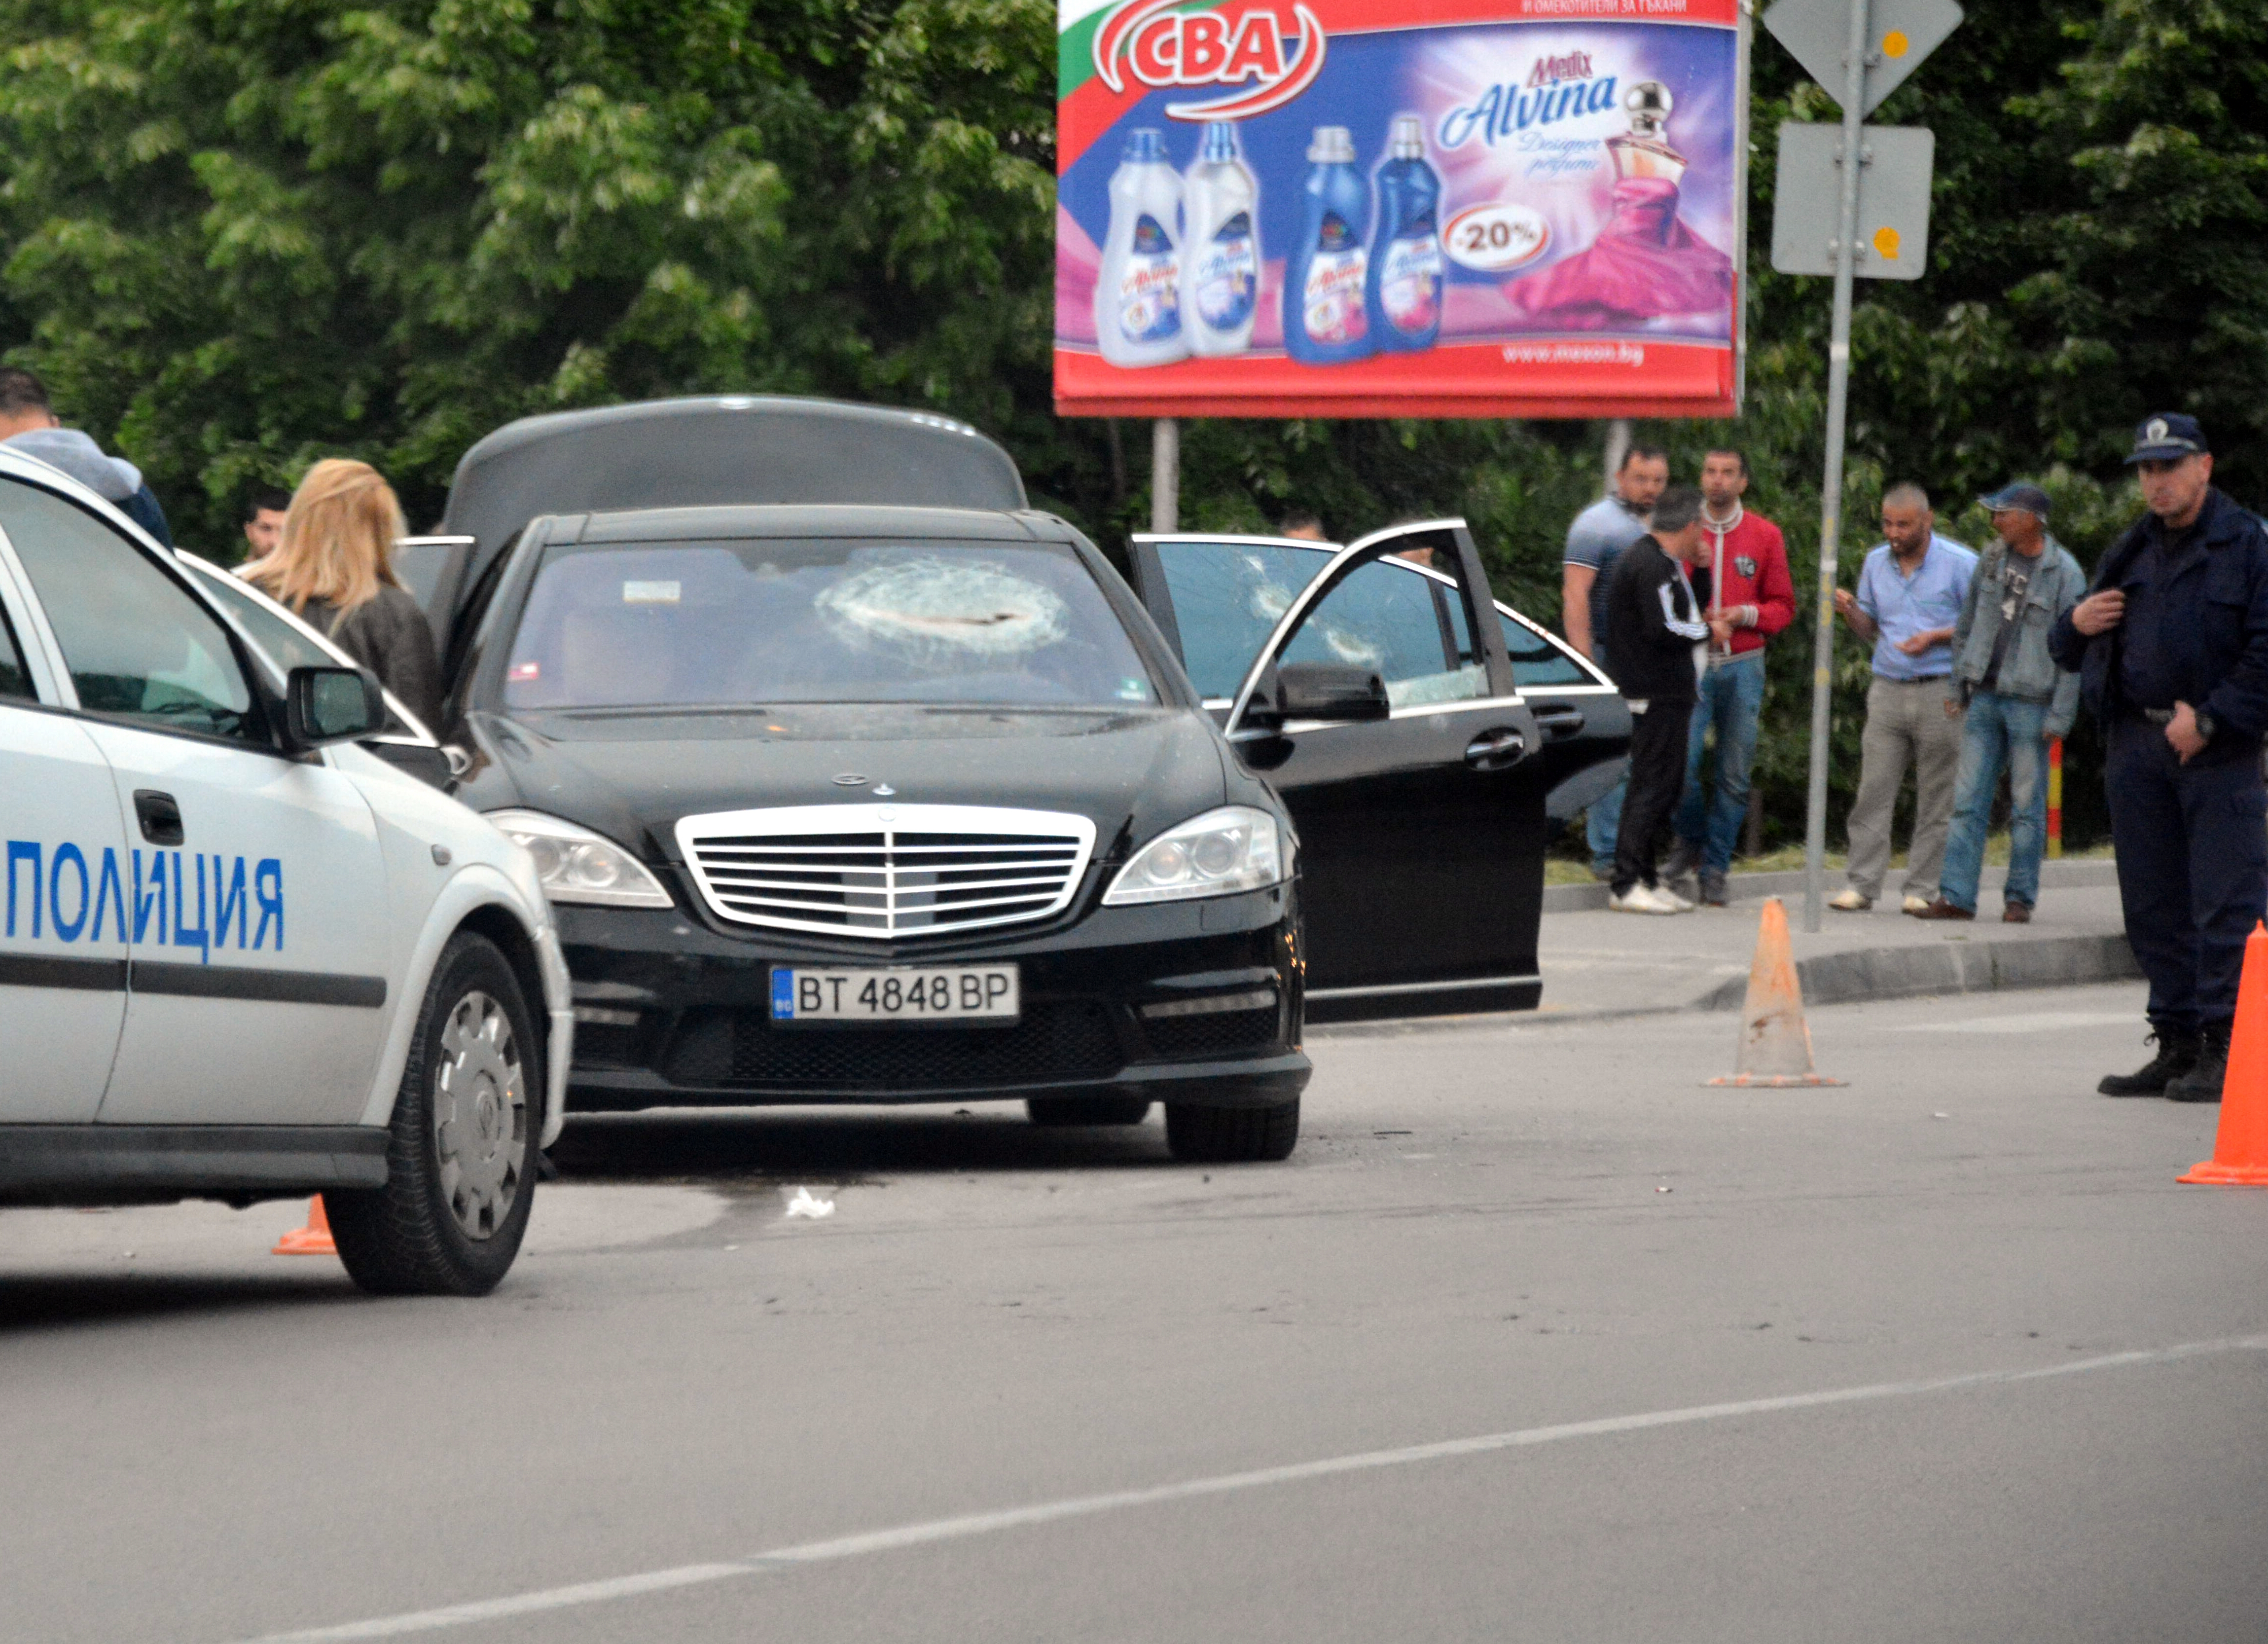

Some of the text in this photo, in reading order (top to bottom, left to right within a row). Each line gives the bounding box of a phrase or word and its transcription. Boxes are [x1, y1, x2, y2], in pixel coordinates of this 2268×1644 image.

[1128, 12, 1288, 86] CBA
[1527, 50, 1593, 88] Medix
[1440, 76, 1618, 147] Alvina
[5, 840, 284, 965] ПОЛИЦИЯ
[858, 975, 951, 1013] 4848
